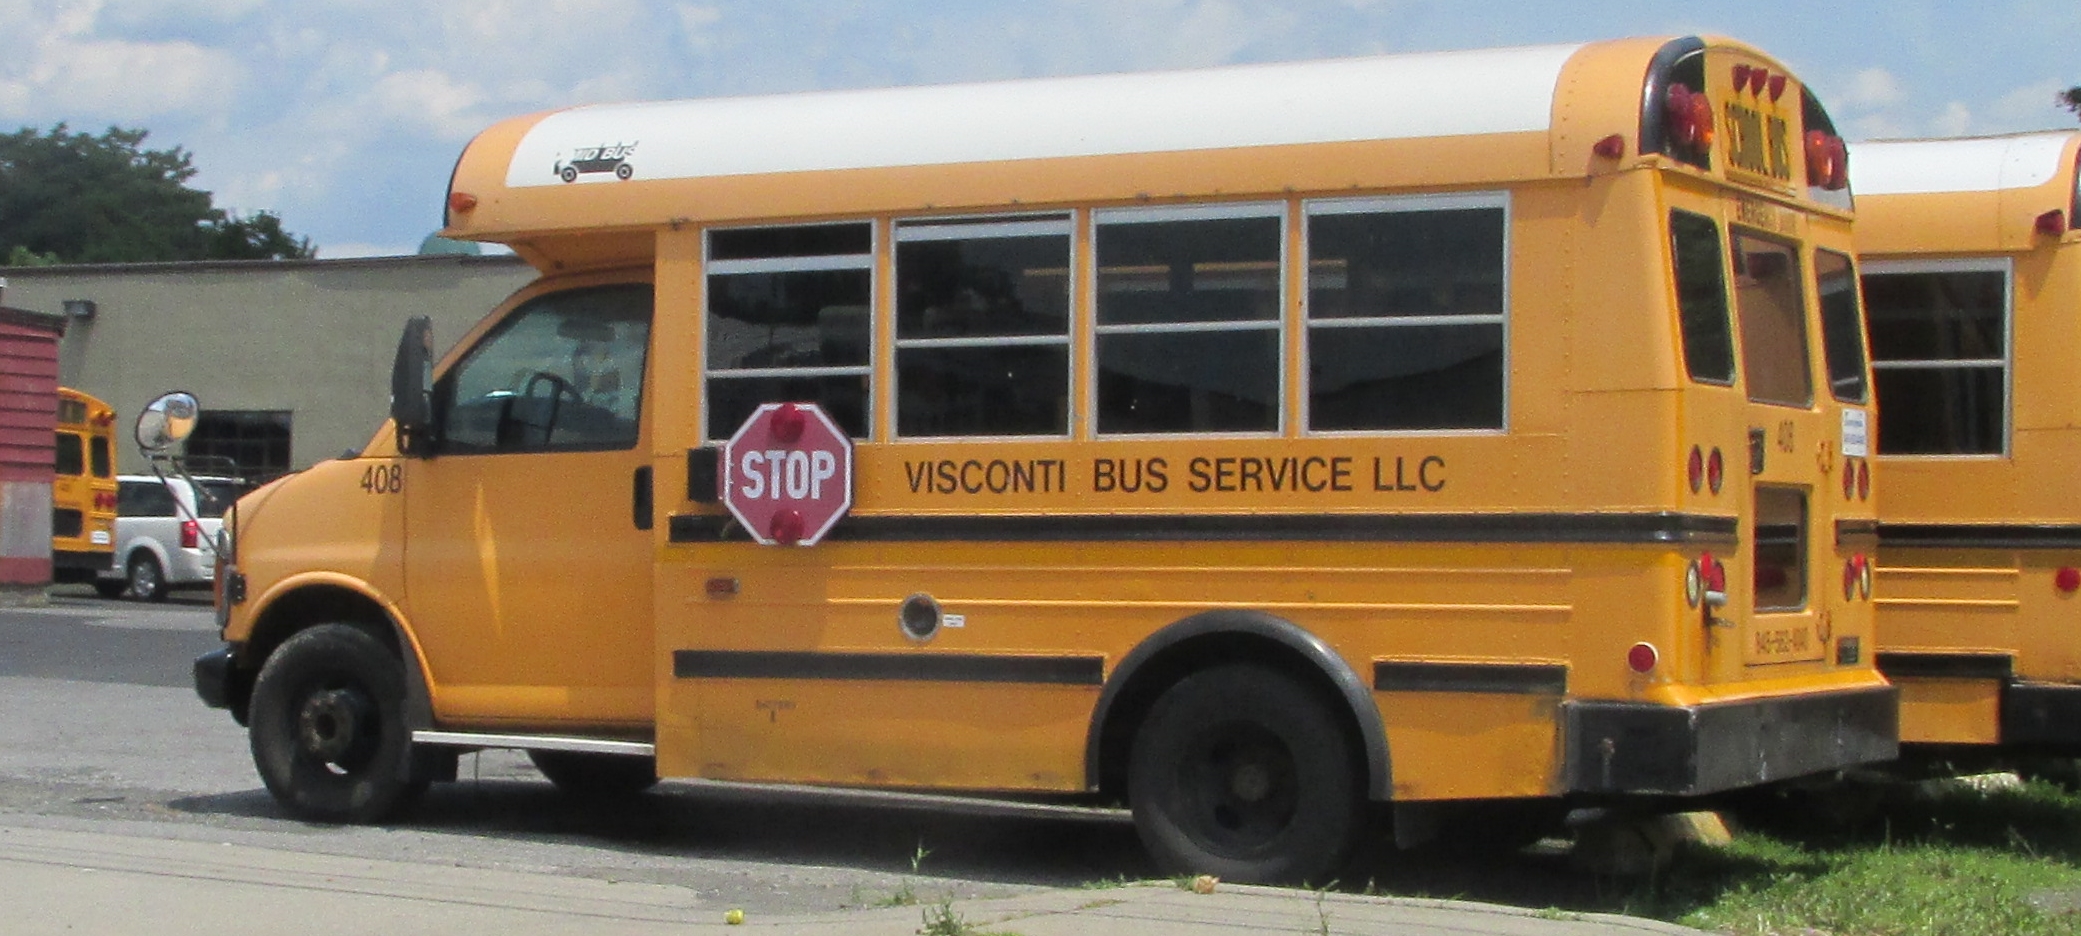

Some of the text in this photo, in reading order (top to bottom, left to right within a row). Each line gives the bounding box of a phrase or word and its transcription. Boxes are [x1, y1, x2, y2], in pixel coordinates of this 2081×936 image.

[600, 145, 636, 160] BUS
[1766, 114, 1790, 181] BUS
[360, 464, 402, 494] 408
[741, 449, 836, 500] STOP
[904, 455, 1446, 494] VISCONTI BUS SERVICE LLC
